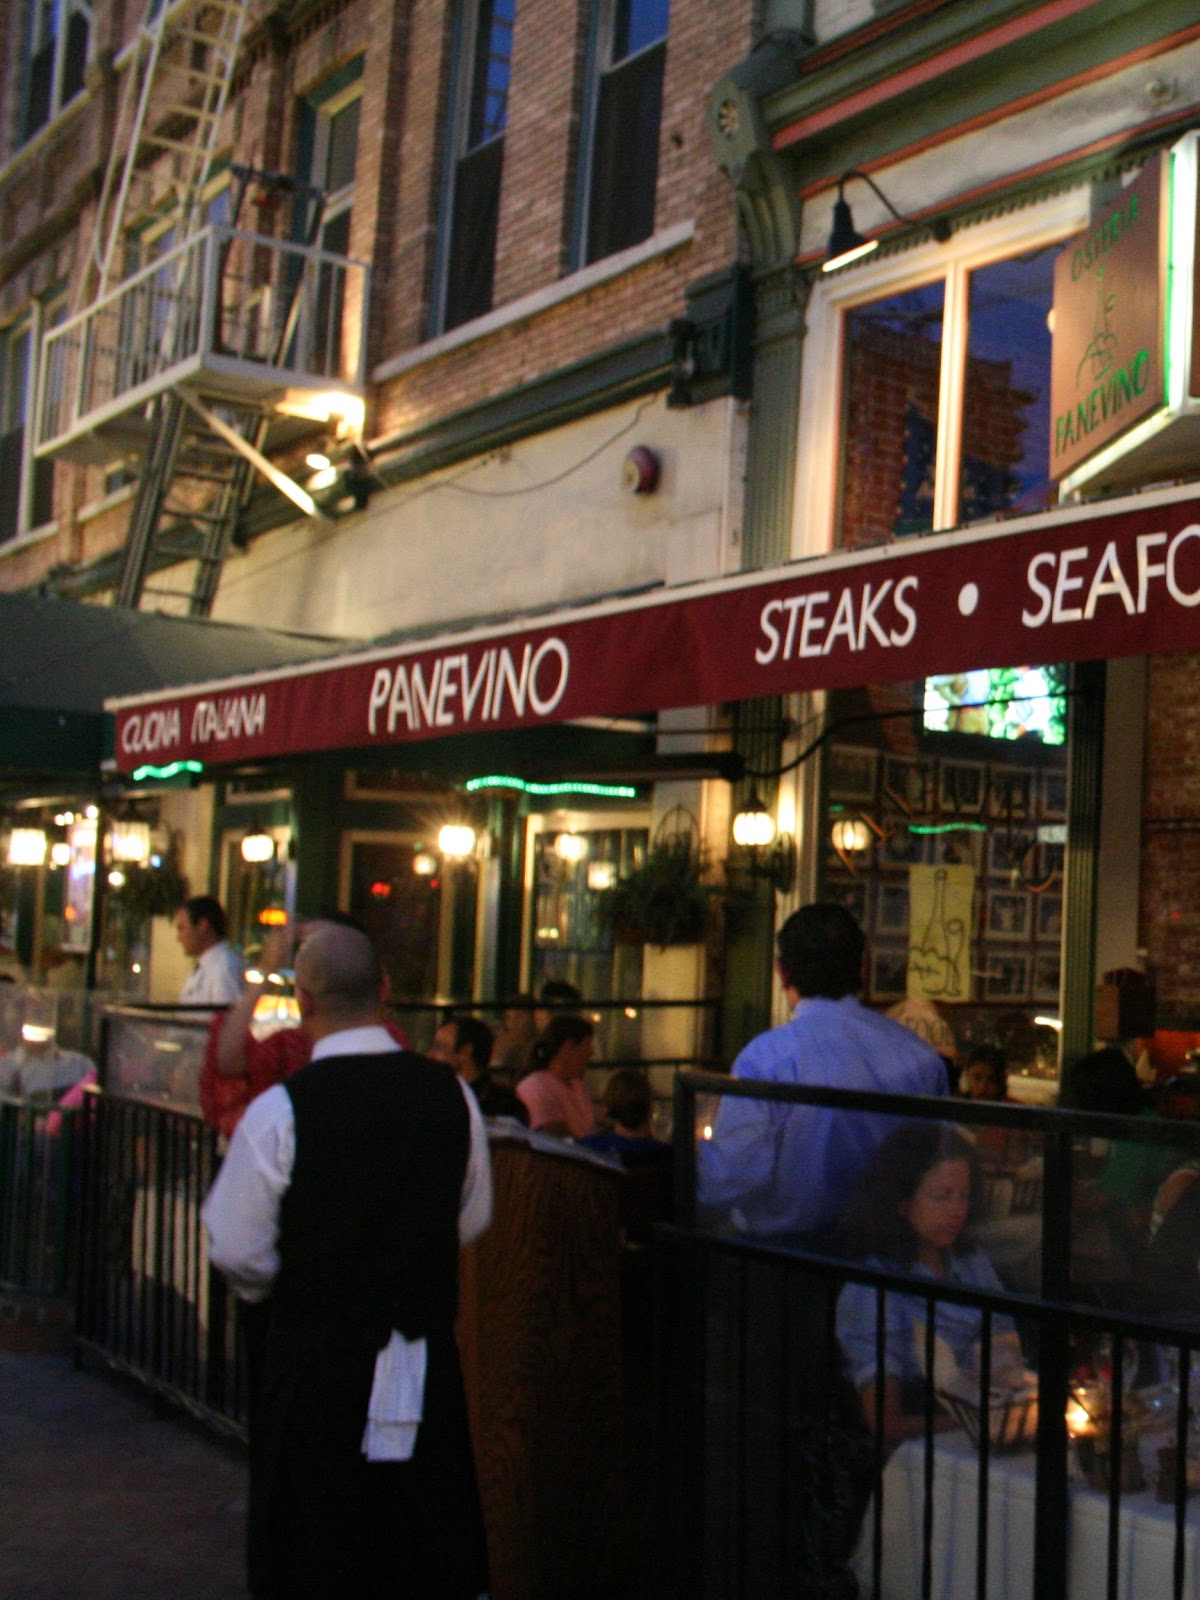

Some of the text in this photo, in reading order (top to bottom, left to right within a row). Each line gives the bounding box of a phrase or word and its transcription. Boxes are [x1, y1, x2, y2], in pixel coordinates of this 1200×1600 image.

[1055, 349, 1151, 458] PANEVINO
[368, 638, 570, 735] PANEVINO
[754, 576, 919, 665] STEAKS
